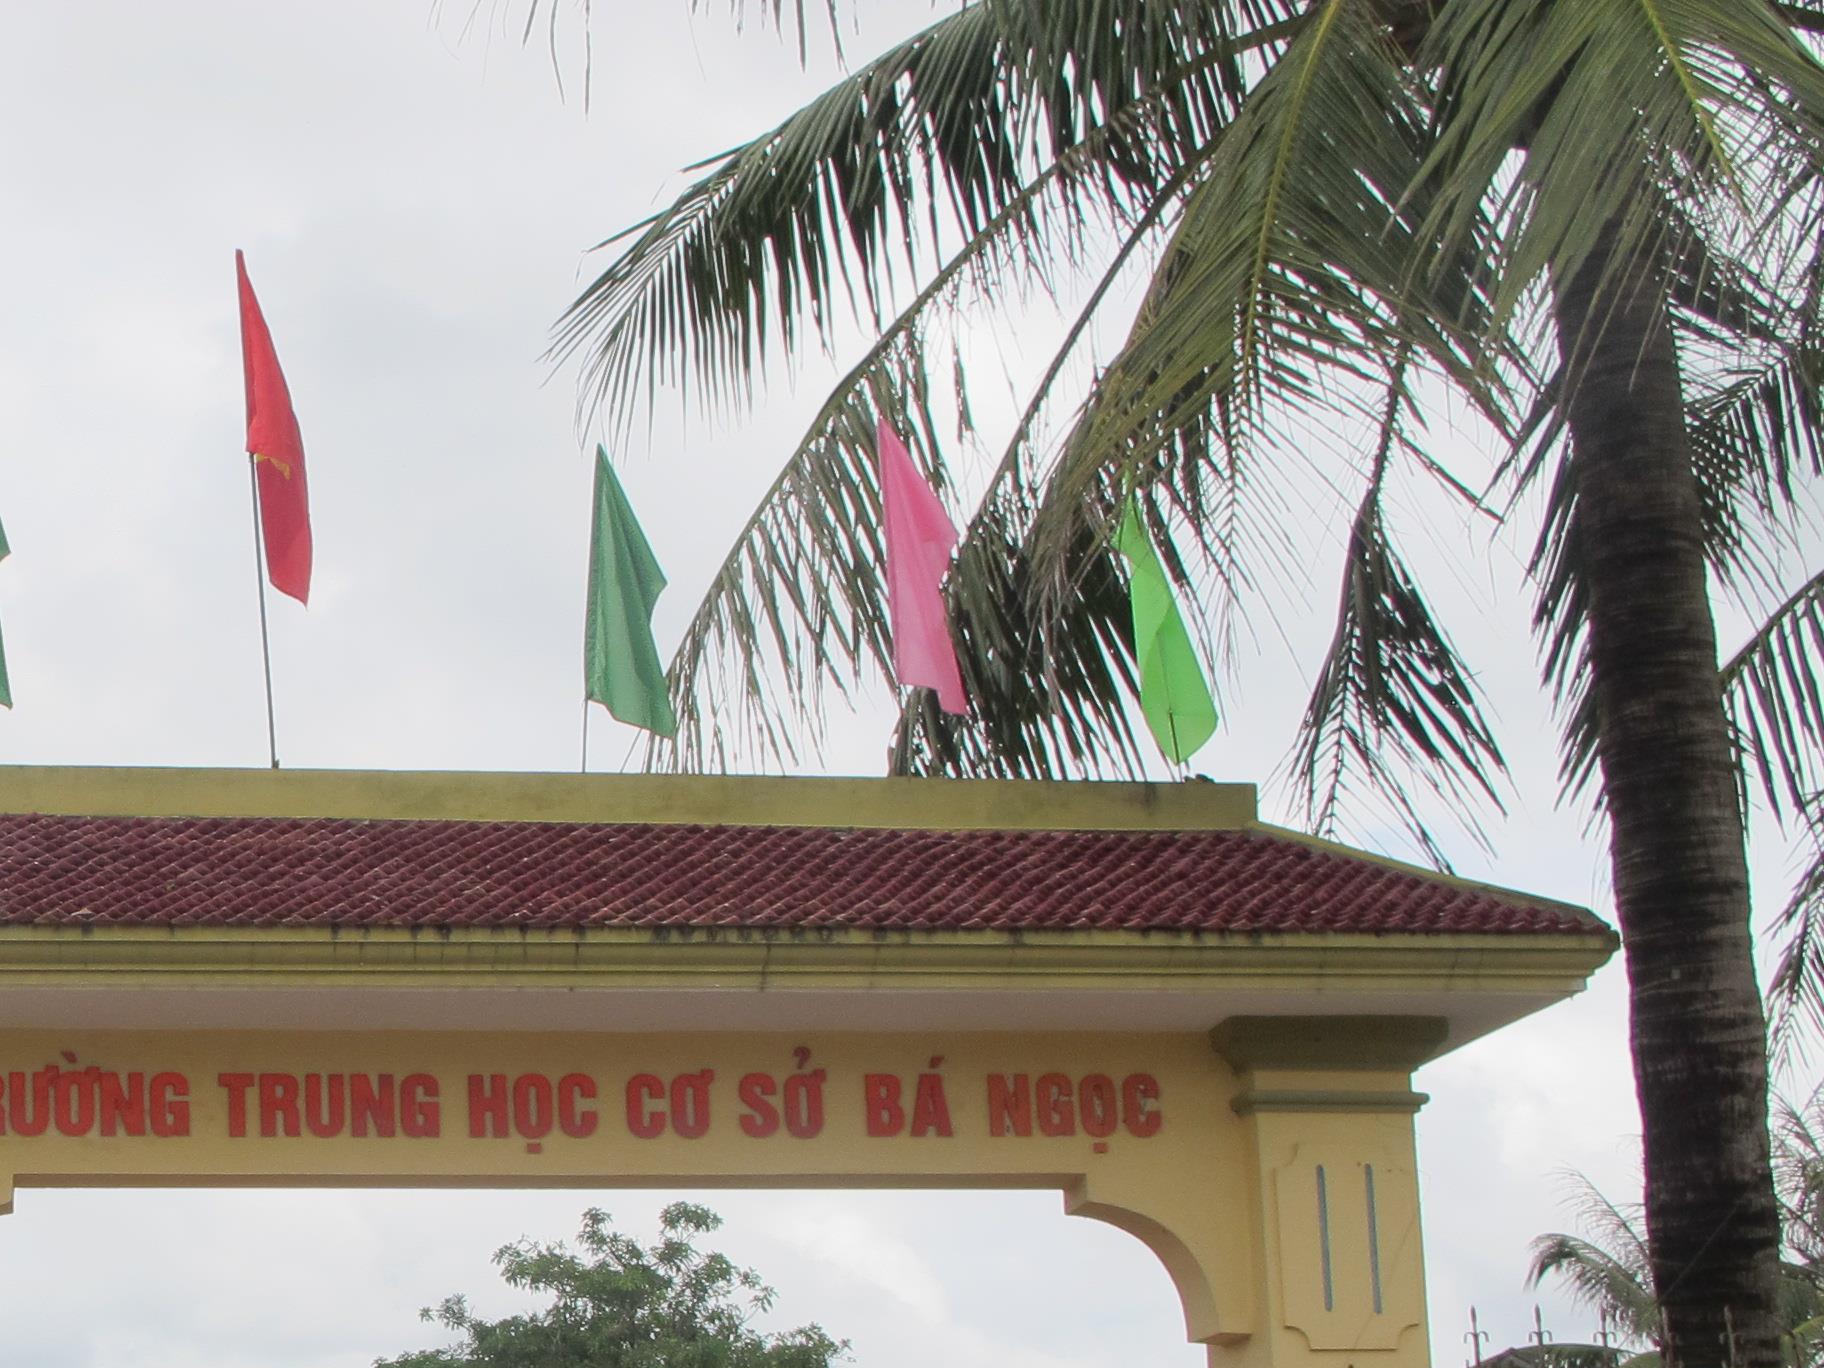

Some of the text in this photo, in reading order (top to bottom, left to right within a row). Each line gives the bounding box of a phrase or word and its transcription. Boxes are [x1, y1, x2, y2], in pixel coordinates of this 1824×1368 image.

[217, 1073, 441, 1138] TRUNG
[467, 1072, 599, 1153] HỌC
[626, 1067, 716, 1139] CƠ
[738, 1046, 826, 1139] SỞ
[864, 1055, 953, 1137] BÁ
[987, 1072, 1162, 1153] NGỌC
